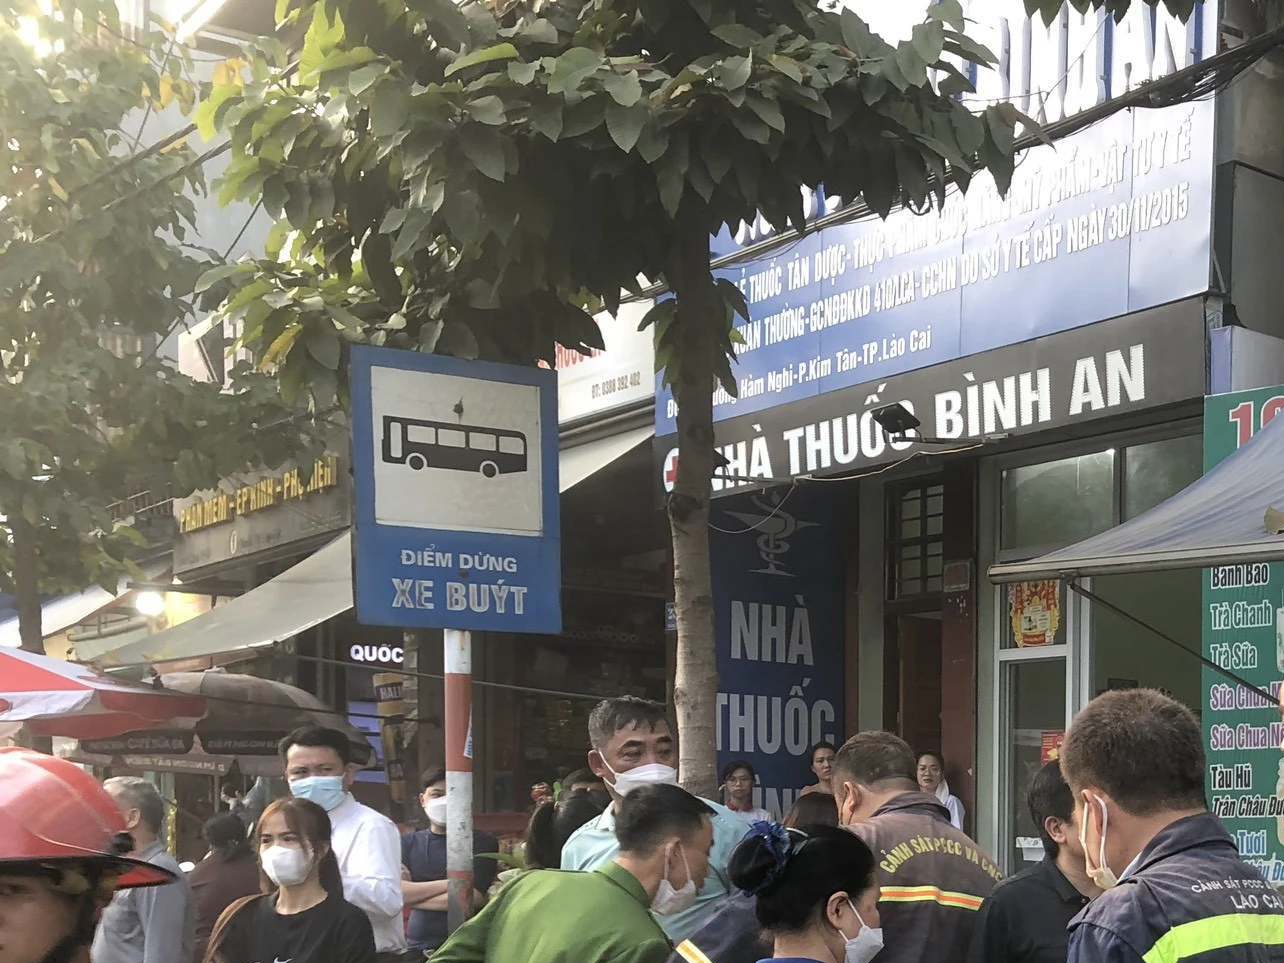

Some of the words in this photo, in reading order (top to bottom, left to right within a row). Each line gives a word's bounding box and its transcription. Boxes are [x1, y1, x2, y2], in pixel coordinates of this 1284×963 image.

[921, 256, 957, 300] CCHN
[961, 251, 979, 287] DO
[981, 233, 1002, 281] SỞ
[1002, 240, 1011, 273] Y
[1014, 220, 1034, 269] TẾ
[1033, 213, 1063, 264] CẤP
[1066, 202, 1108, 254] NGÀY
[1108, 181, 1190, 241] 30/11/2015
[749, 258, 783, 304] THUỐC
[787, 252, 810, 291] TÂN
[740, 374, 765, 399] Hàm
[909, 325, 932, 352] Cai
[783, 383, 917, 476] THUỐC
[934, 368, 1051, 440] BÌNH
[1069, 343, 1146, 417] AN
[400, 544, 452, 569] ĐIỂM
[459, 552, 518, 573] DỪNG
[1244, 563, 1270, 587] Bao
[391, 578, 434, 610] XE
[446, 579, 528, 615] BUÝT
[1210, 602, 1231, 630] Trà
[1232, 600, 1273, 628] Chanh
[731, 594, 814, 666] NHÀ
[350, 643, 405, 664] QUỐC
[1210, 643, 1231, 670] Trà
[1232, 641, 1258, 669] Sữa
[1210, 683, 1235, 711] Sữa
[715, 677, 836, 756] THUỐC
[1210, 723, 1235, 750] Sữa
[1236, 723, 1268, 749] Chua
[1210, 765, 1234, 790] Tàu
[1235, 763, 1252, 790] Hũ
[1212, 796, 1236, 817] Trân
[1238, 795, 1268, 818] Châu
[879, 842, 914, 874] CẢNH
[909, 834, 935, 854] SÁT
[1237, 829, 1267, 856] Tươi
[1223, 876, 1241, 889] SÁT
[1230, 890, 1259, 909] LÀO
